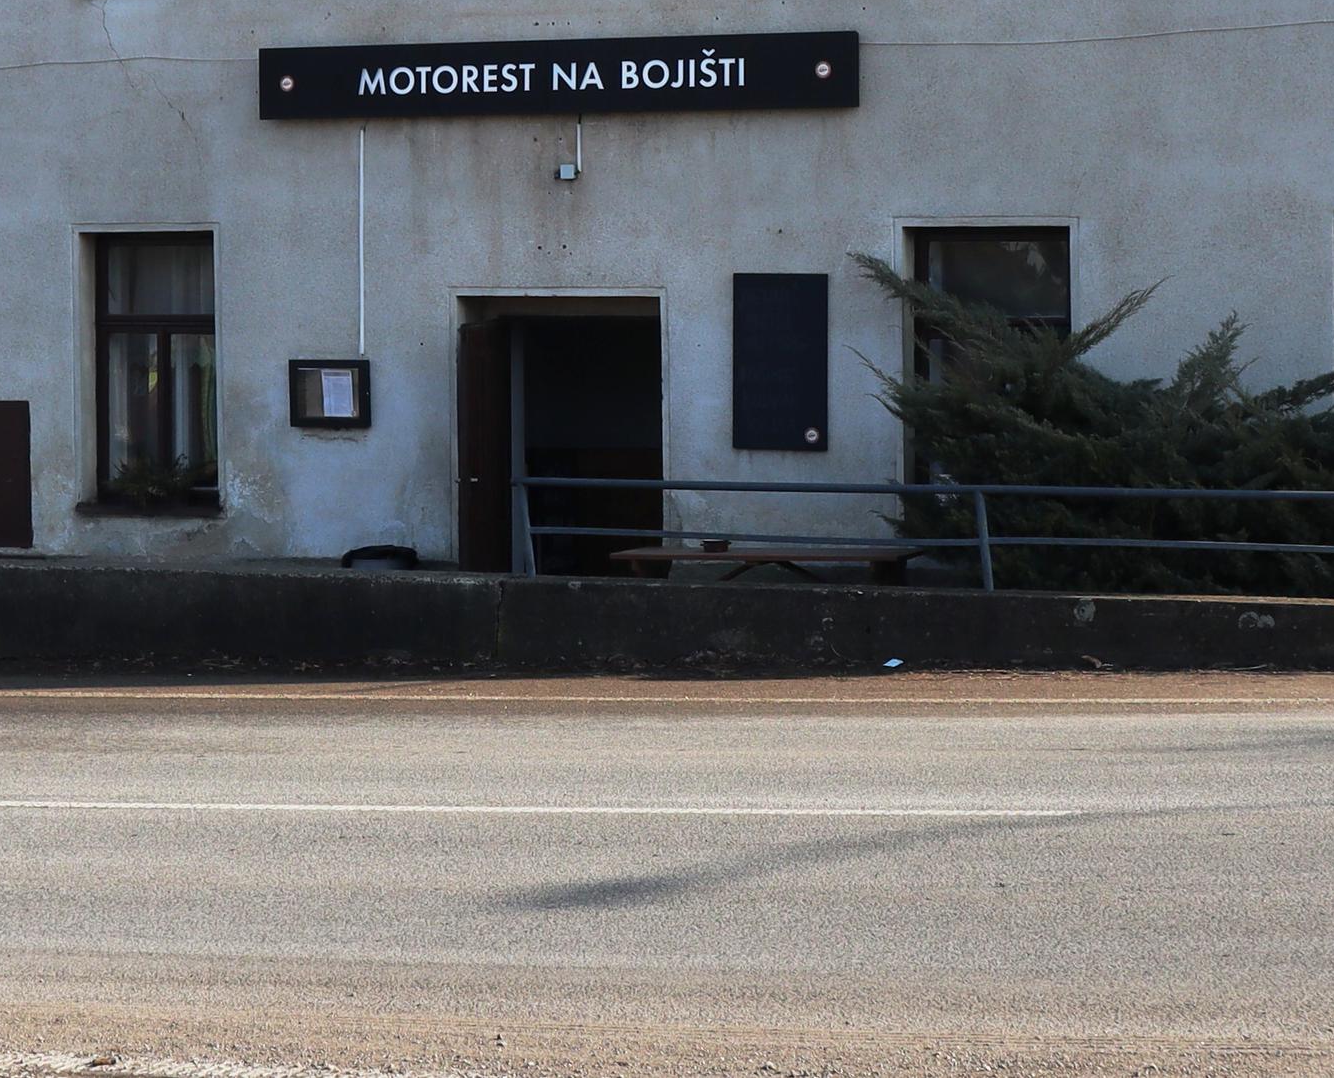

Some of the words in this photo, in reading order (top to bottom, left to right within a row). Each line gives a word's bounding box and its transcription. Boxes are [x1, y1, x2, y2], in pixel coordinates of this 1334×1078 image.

[357, 62, 536, 97] MOTOREST
[551, 61, 605, 91] NA
[620, 47, 746, 90] BOJIŠTI
